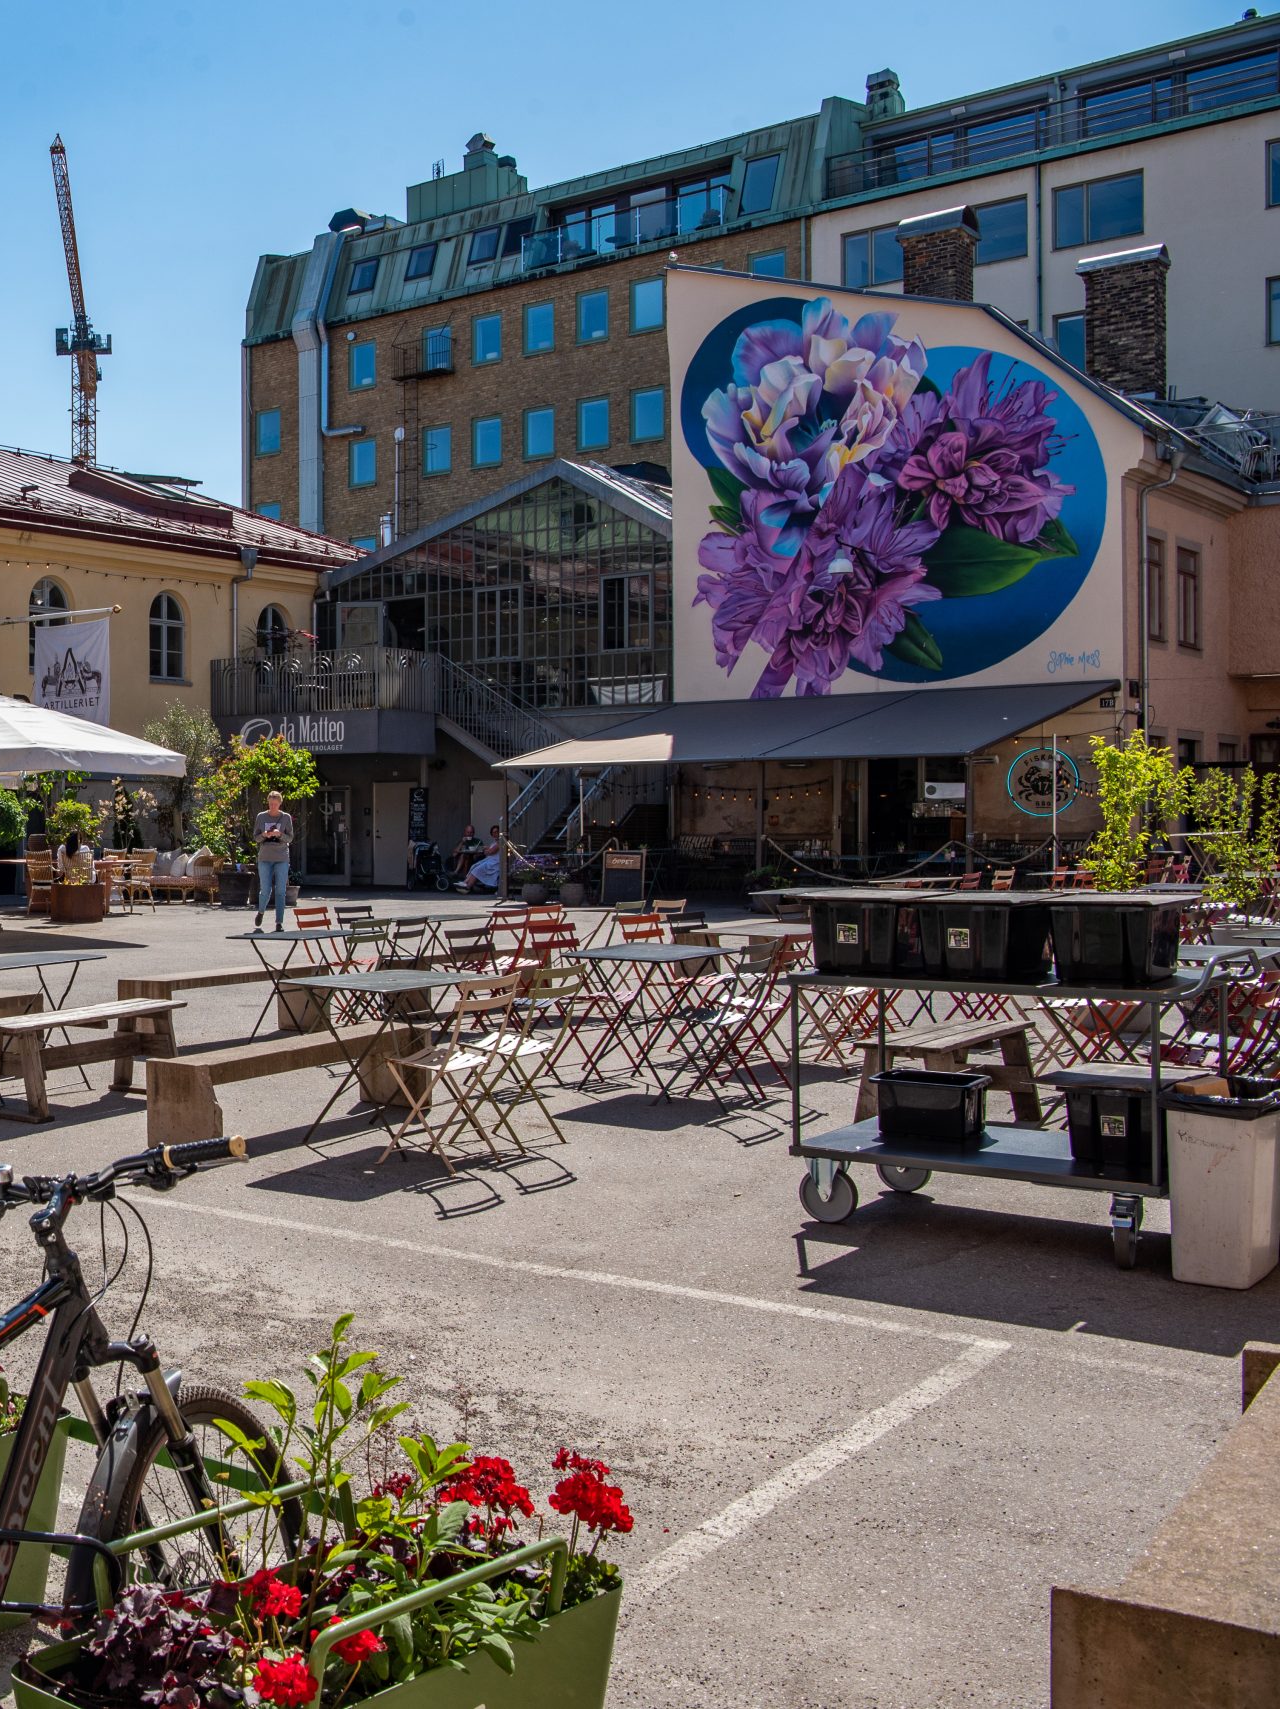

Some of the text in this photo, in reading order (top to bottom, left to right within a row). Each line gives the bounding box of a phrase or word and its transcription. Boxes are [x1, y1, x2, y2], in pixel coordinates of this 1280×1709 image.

[45, 697, 100, 710] ARTILLERIET
[280, 716, 344, 743] da Matteo
[1039, 782, 1049, 791] 17
